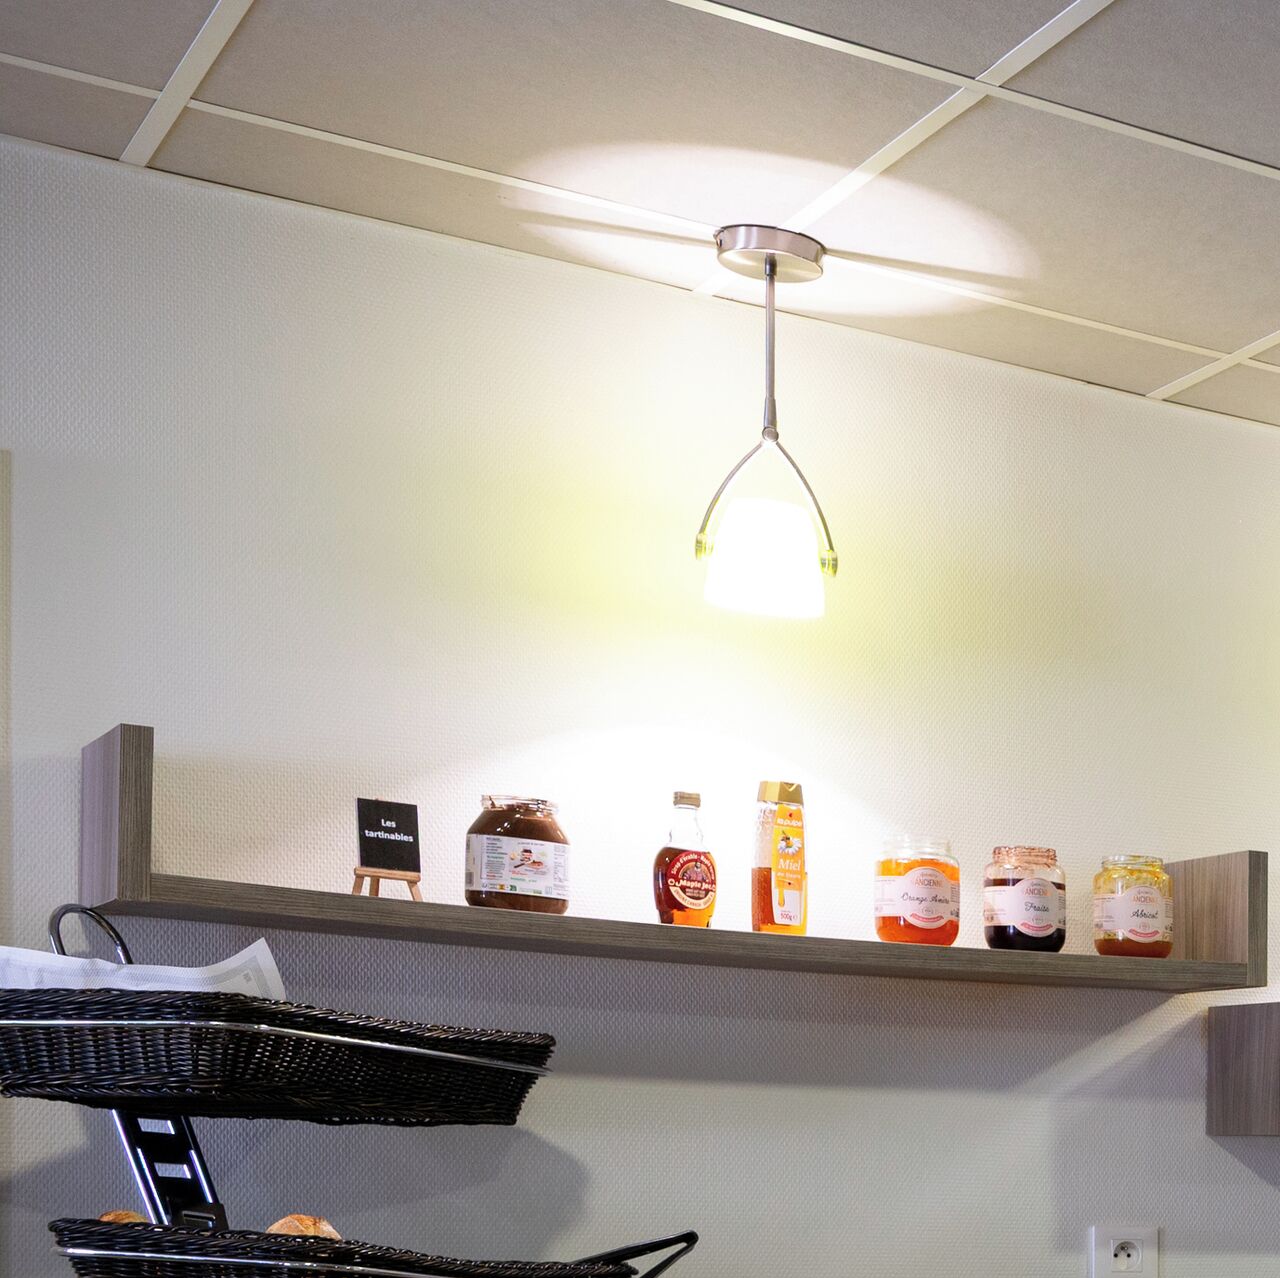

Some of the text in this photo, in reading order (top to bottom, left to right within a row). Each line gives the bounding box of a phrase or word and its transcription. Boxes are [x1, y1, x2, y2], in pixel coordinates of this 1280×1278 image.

[381, 818, 396, 828] Les
[364, 830, 414, 842] tartinables
[778, 859, 801, 871] Miel
[901, 892, 928, 905] Orange
[1024, 901, 1049, 912] Fraise
[1131, 908, 1158, 919] Abricot
